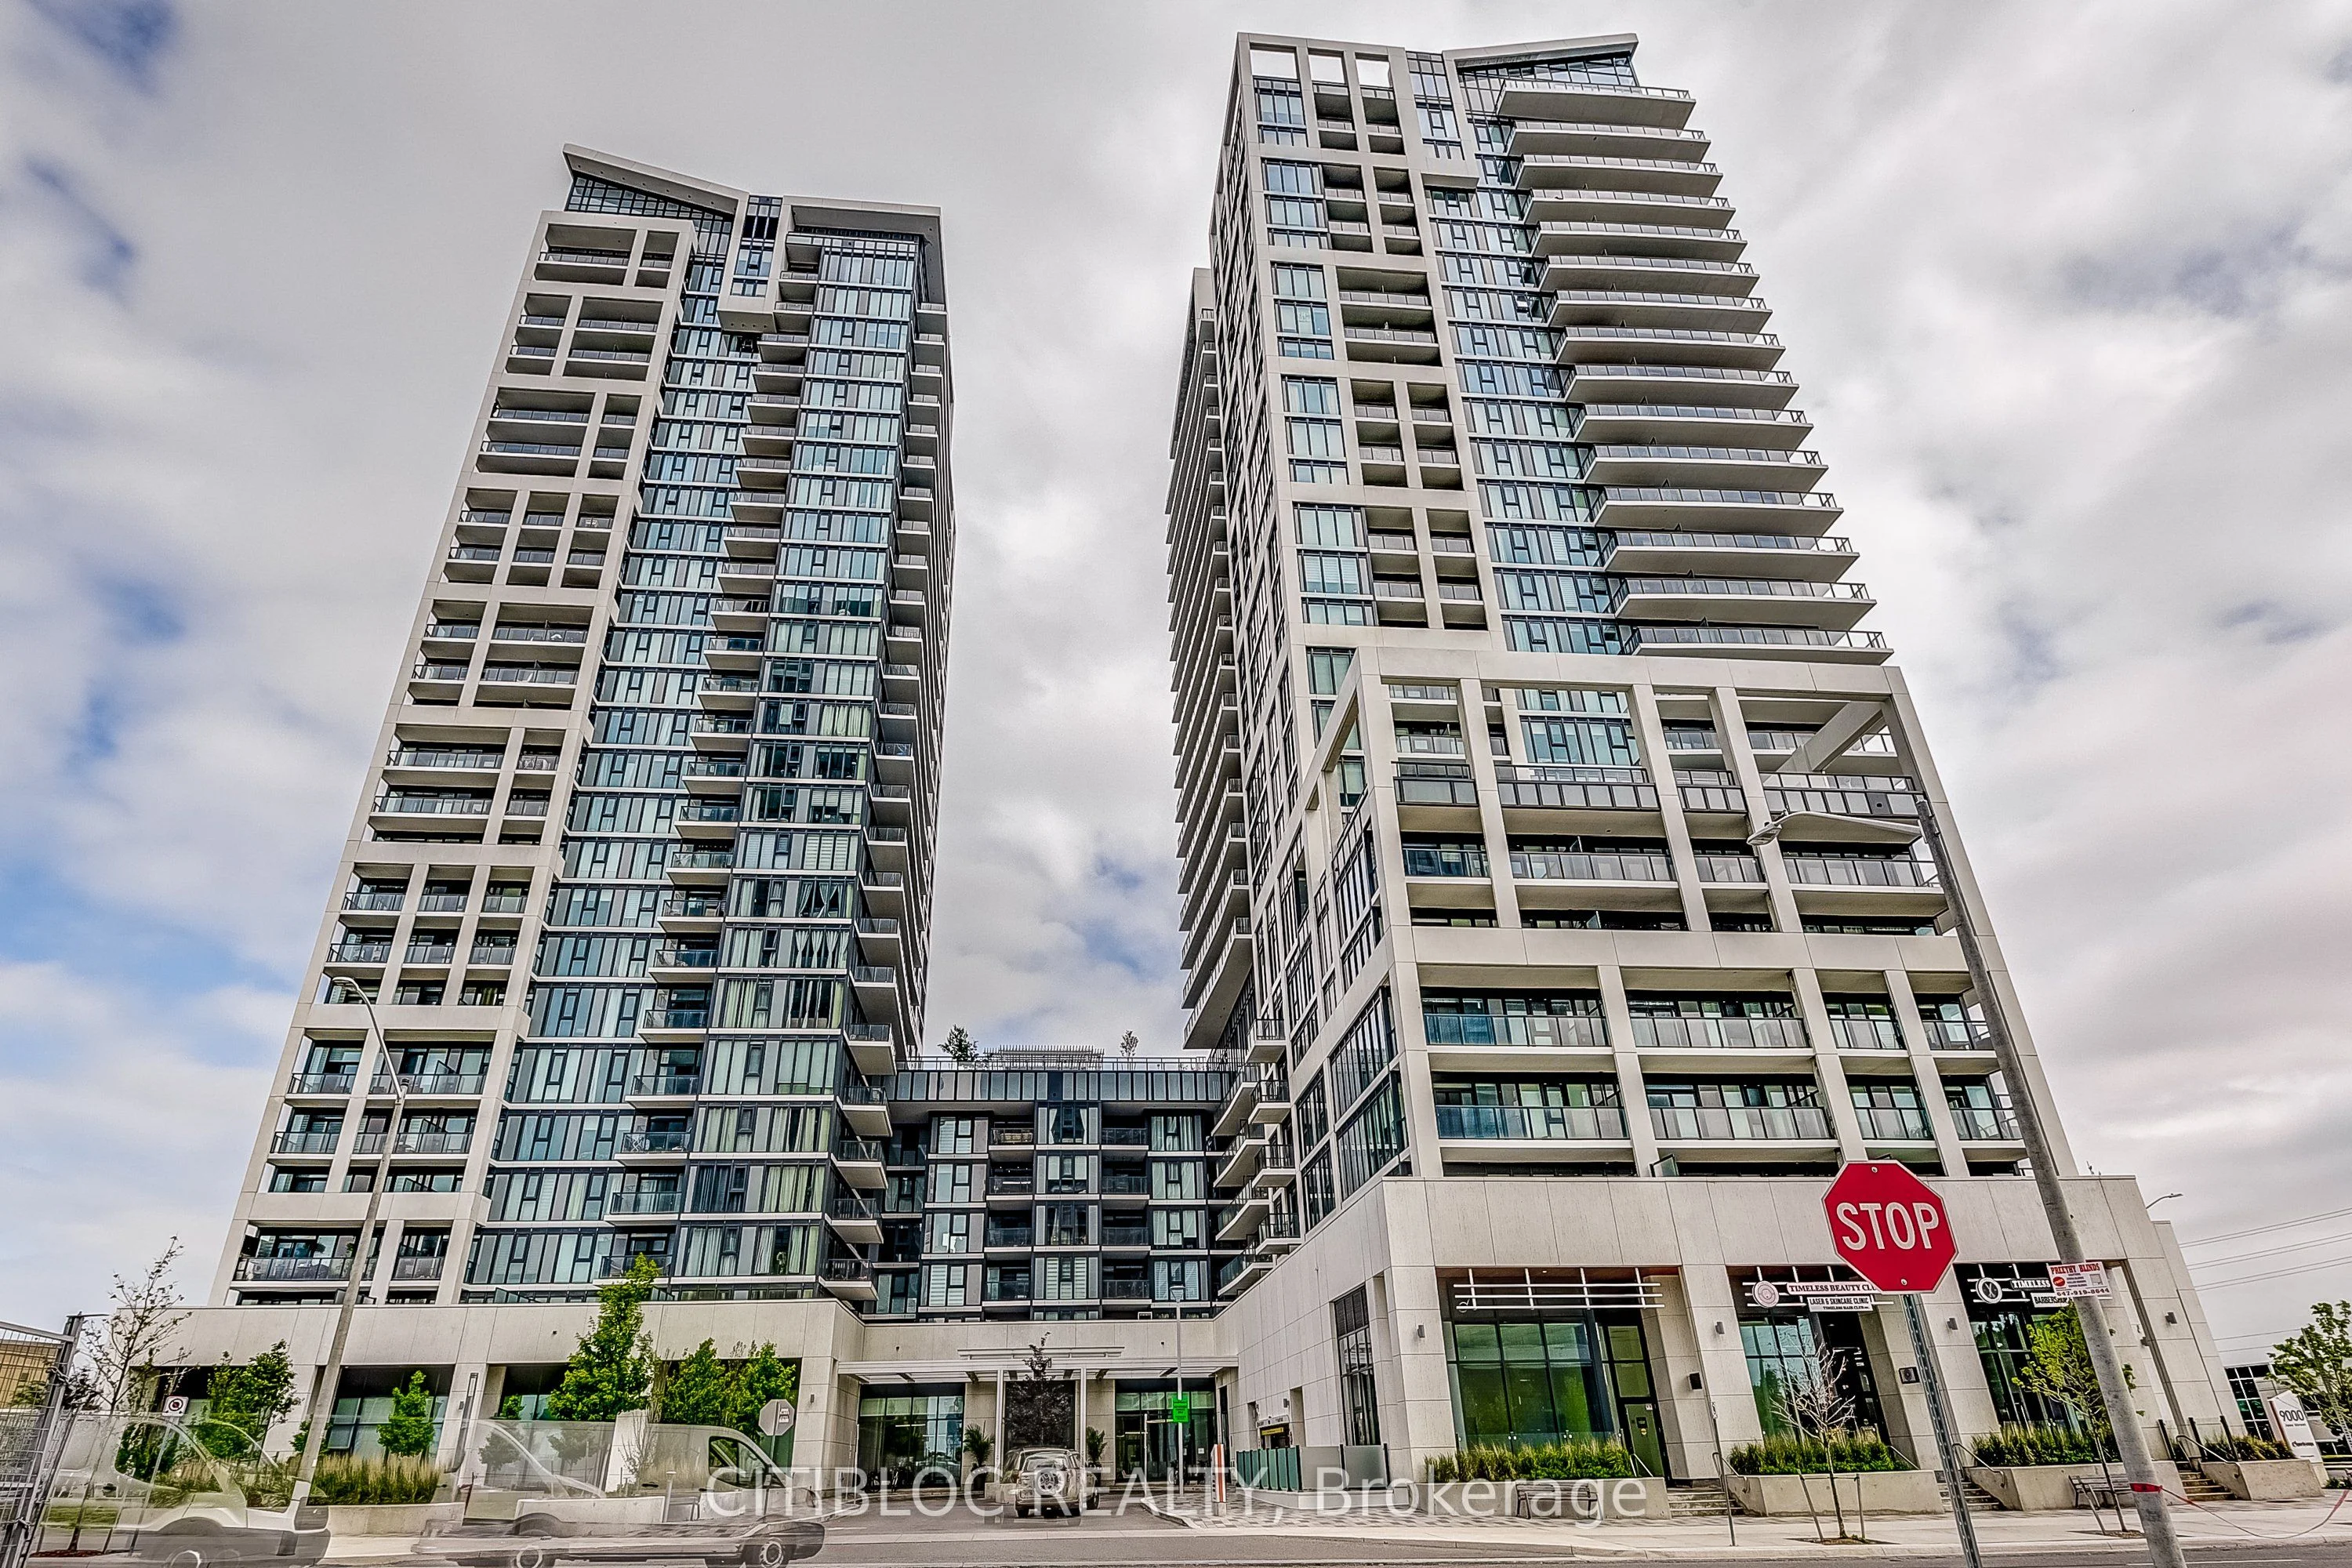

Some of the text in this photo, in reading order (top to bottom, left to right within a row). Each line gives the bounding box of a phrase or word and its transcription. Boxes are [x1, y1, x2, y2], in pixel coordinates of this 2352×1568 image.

[1836, 1202, 1940, 1250] STOP
[2078, 1263, 2100, 1272] BLINDS
[2011, 1279, 2051, 1288] TIMELESS
[2056, 1288, 2110, 1297] 647-919-8644
[2279, 1410, 2305, 1421] 9000
